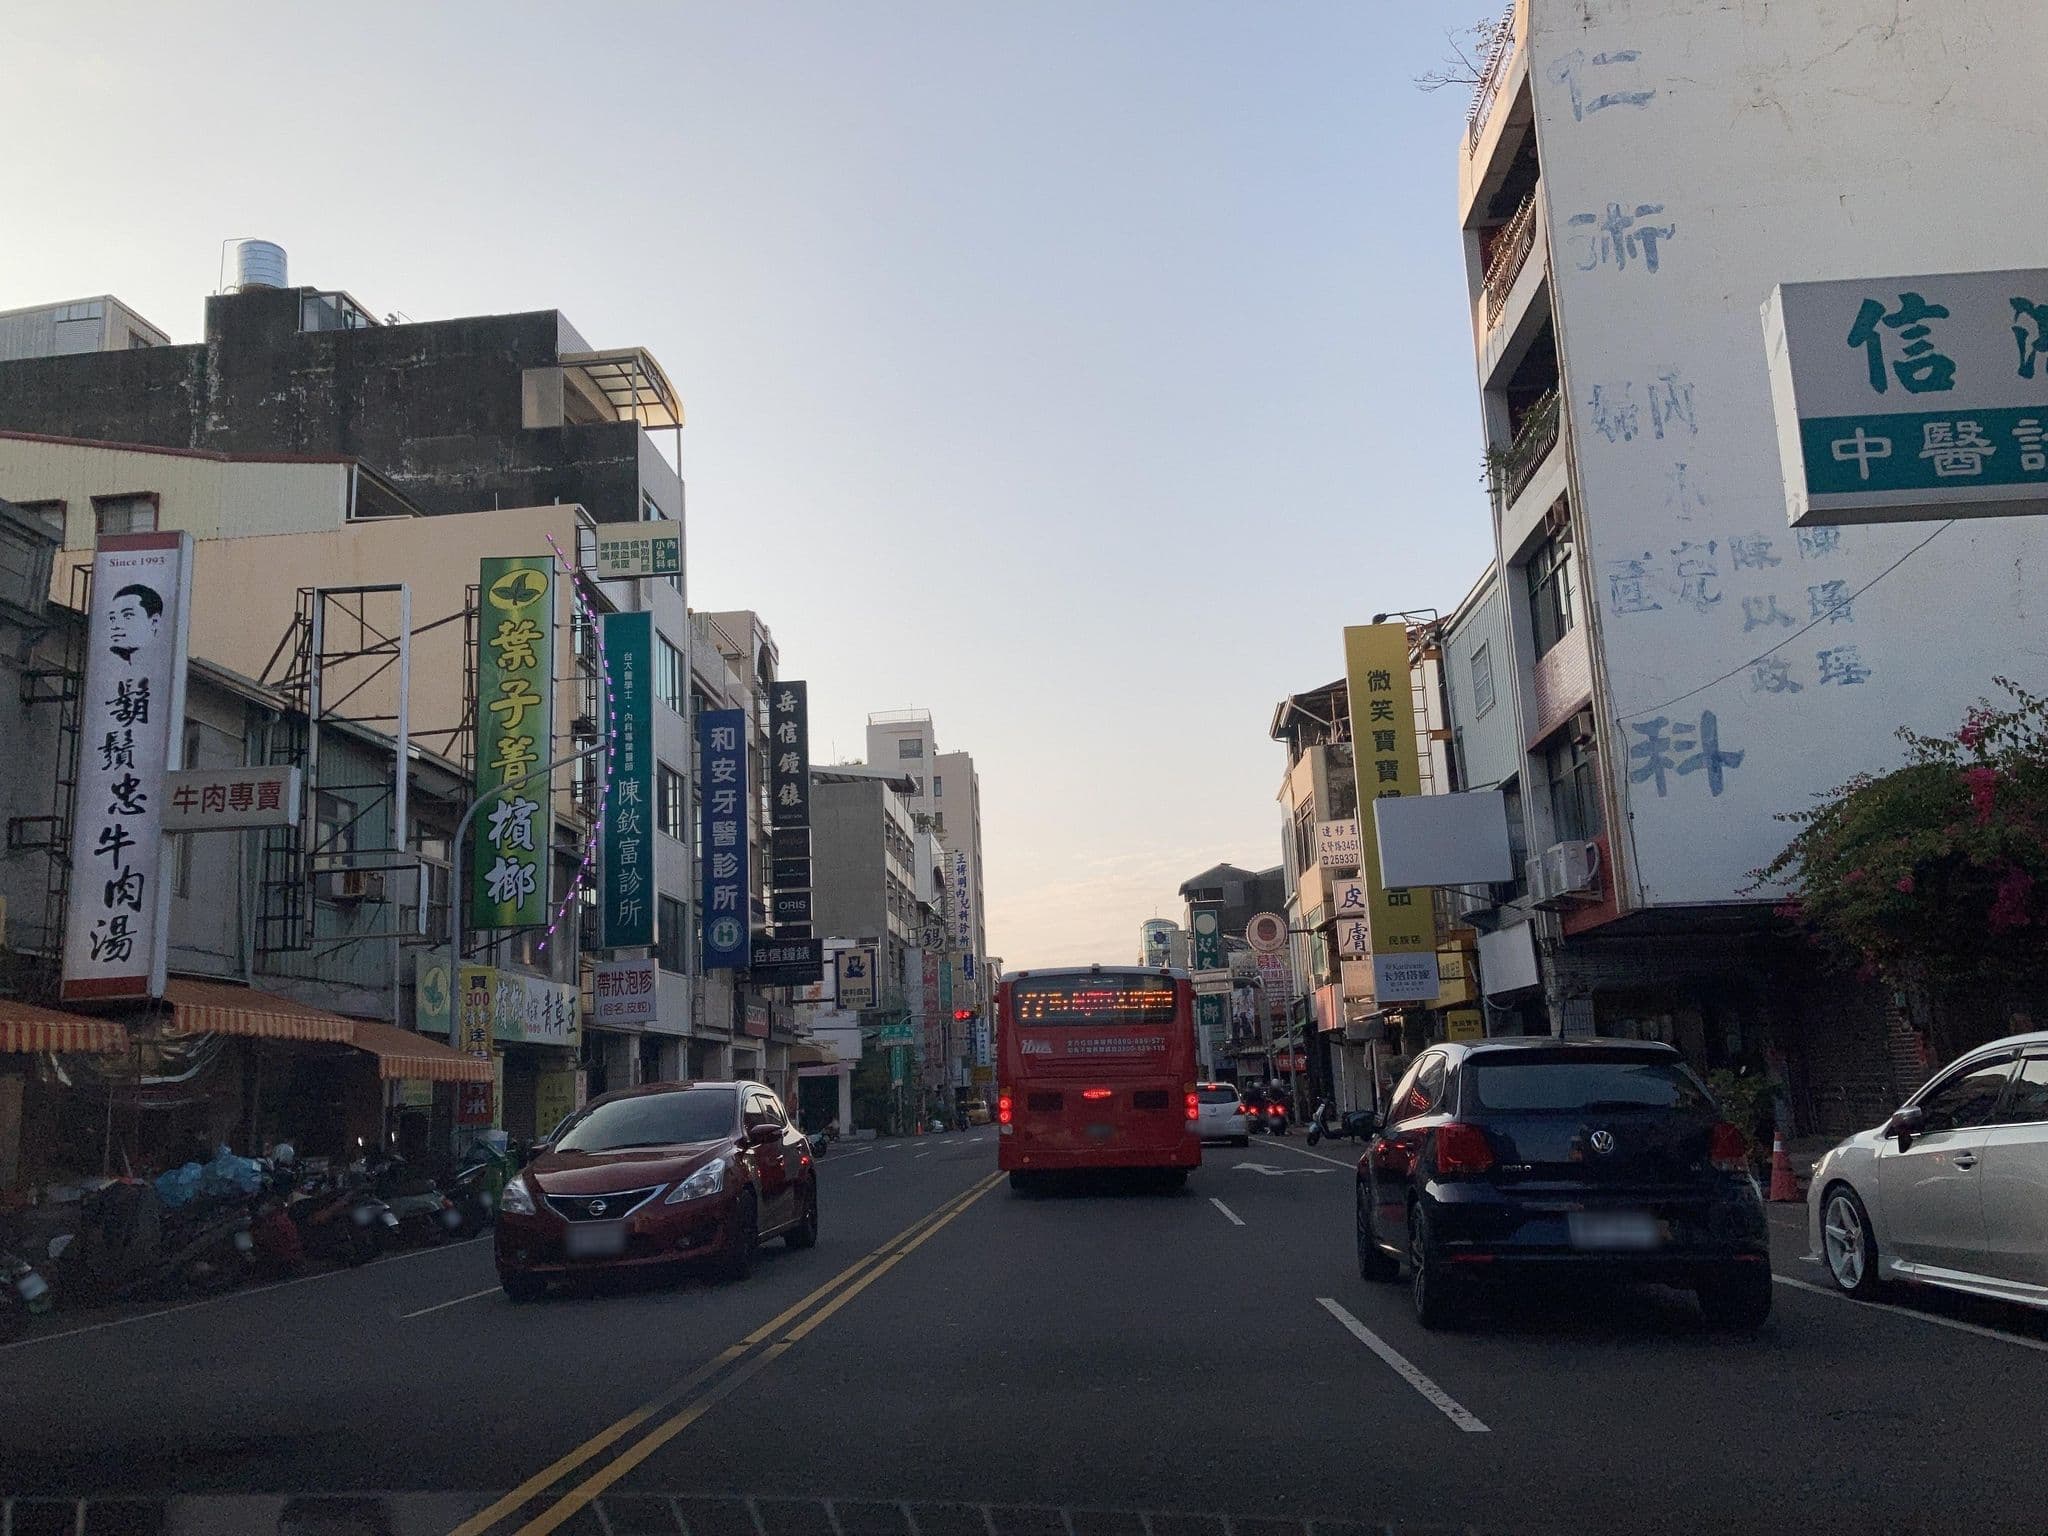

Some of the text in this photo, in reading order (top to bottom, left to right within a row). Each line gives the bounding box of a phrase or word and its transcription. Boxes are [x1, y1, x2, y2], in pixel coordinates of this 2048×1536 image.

[109, 556, 166, 569] Since 1993
[484, 619, 544, 912] 葉子菁檳榔
[1630, 709, 1744, 798] 科
[172, 780, 283, 815] 牛肉專賣
[90, 676, 149, 964] 鬍鬚忠牛肉湯
[710, 734, 738, 919] 和安牙醫診所
[779, 900, 807, 911] ORIS
[1341, 883, 1368, 952] 皮膚
[754, 946, 811, 963] 岳信鐘錶
[1387, 935, 1422, 949] 民族店
[465, 992, 490, 1007] 300
[597, 969, 653, 998] 帶狀泡疹
